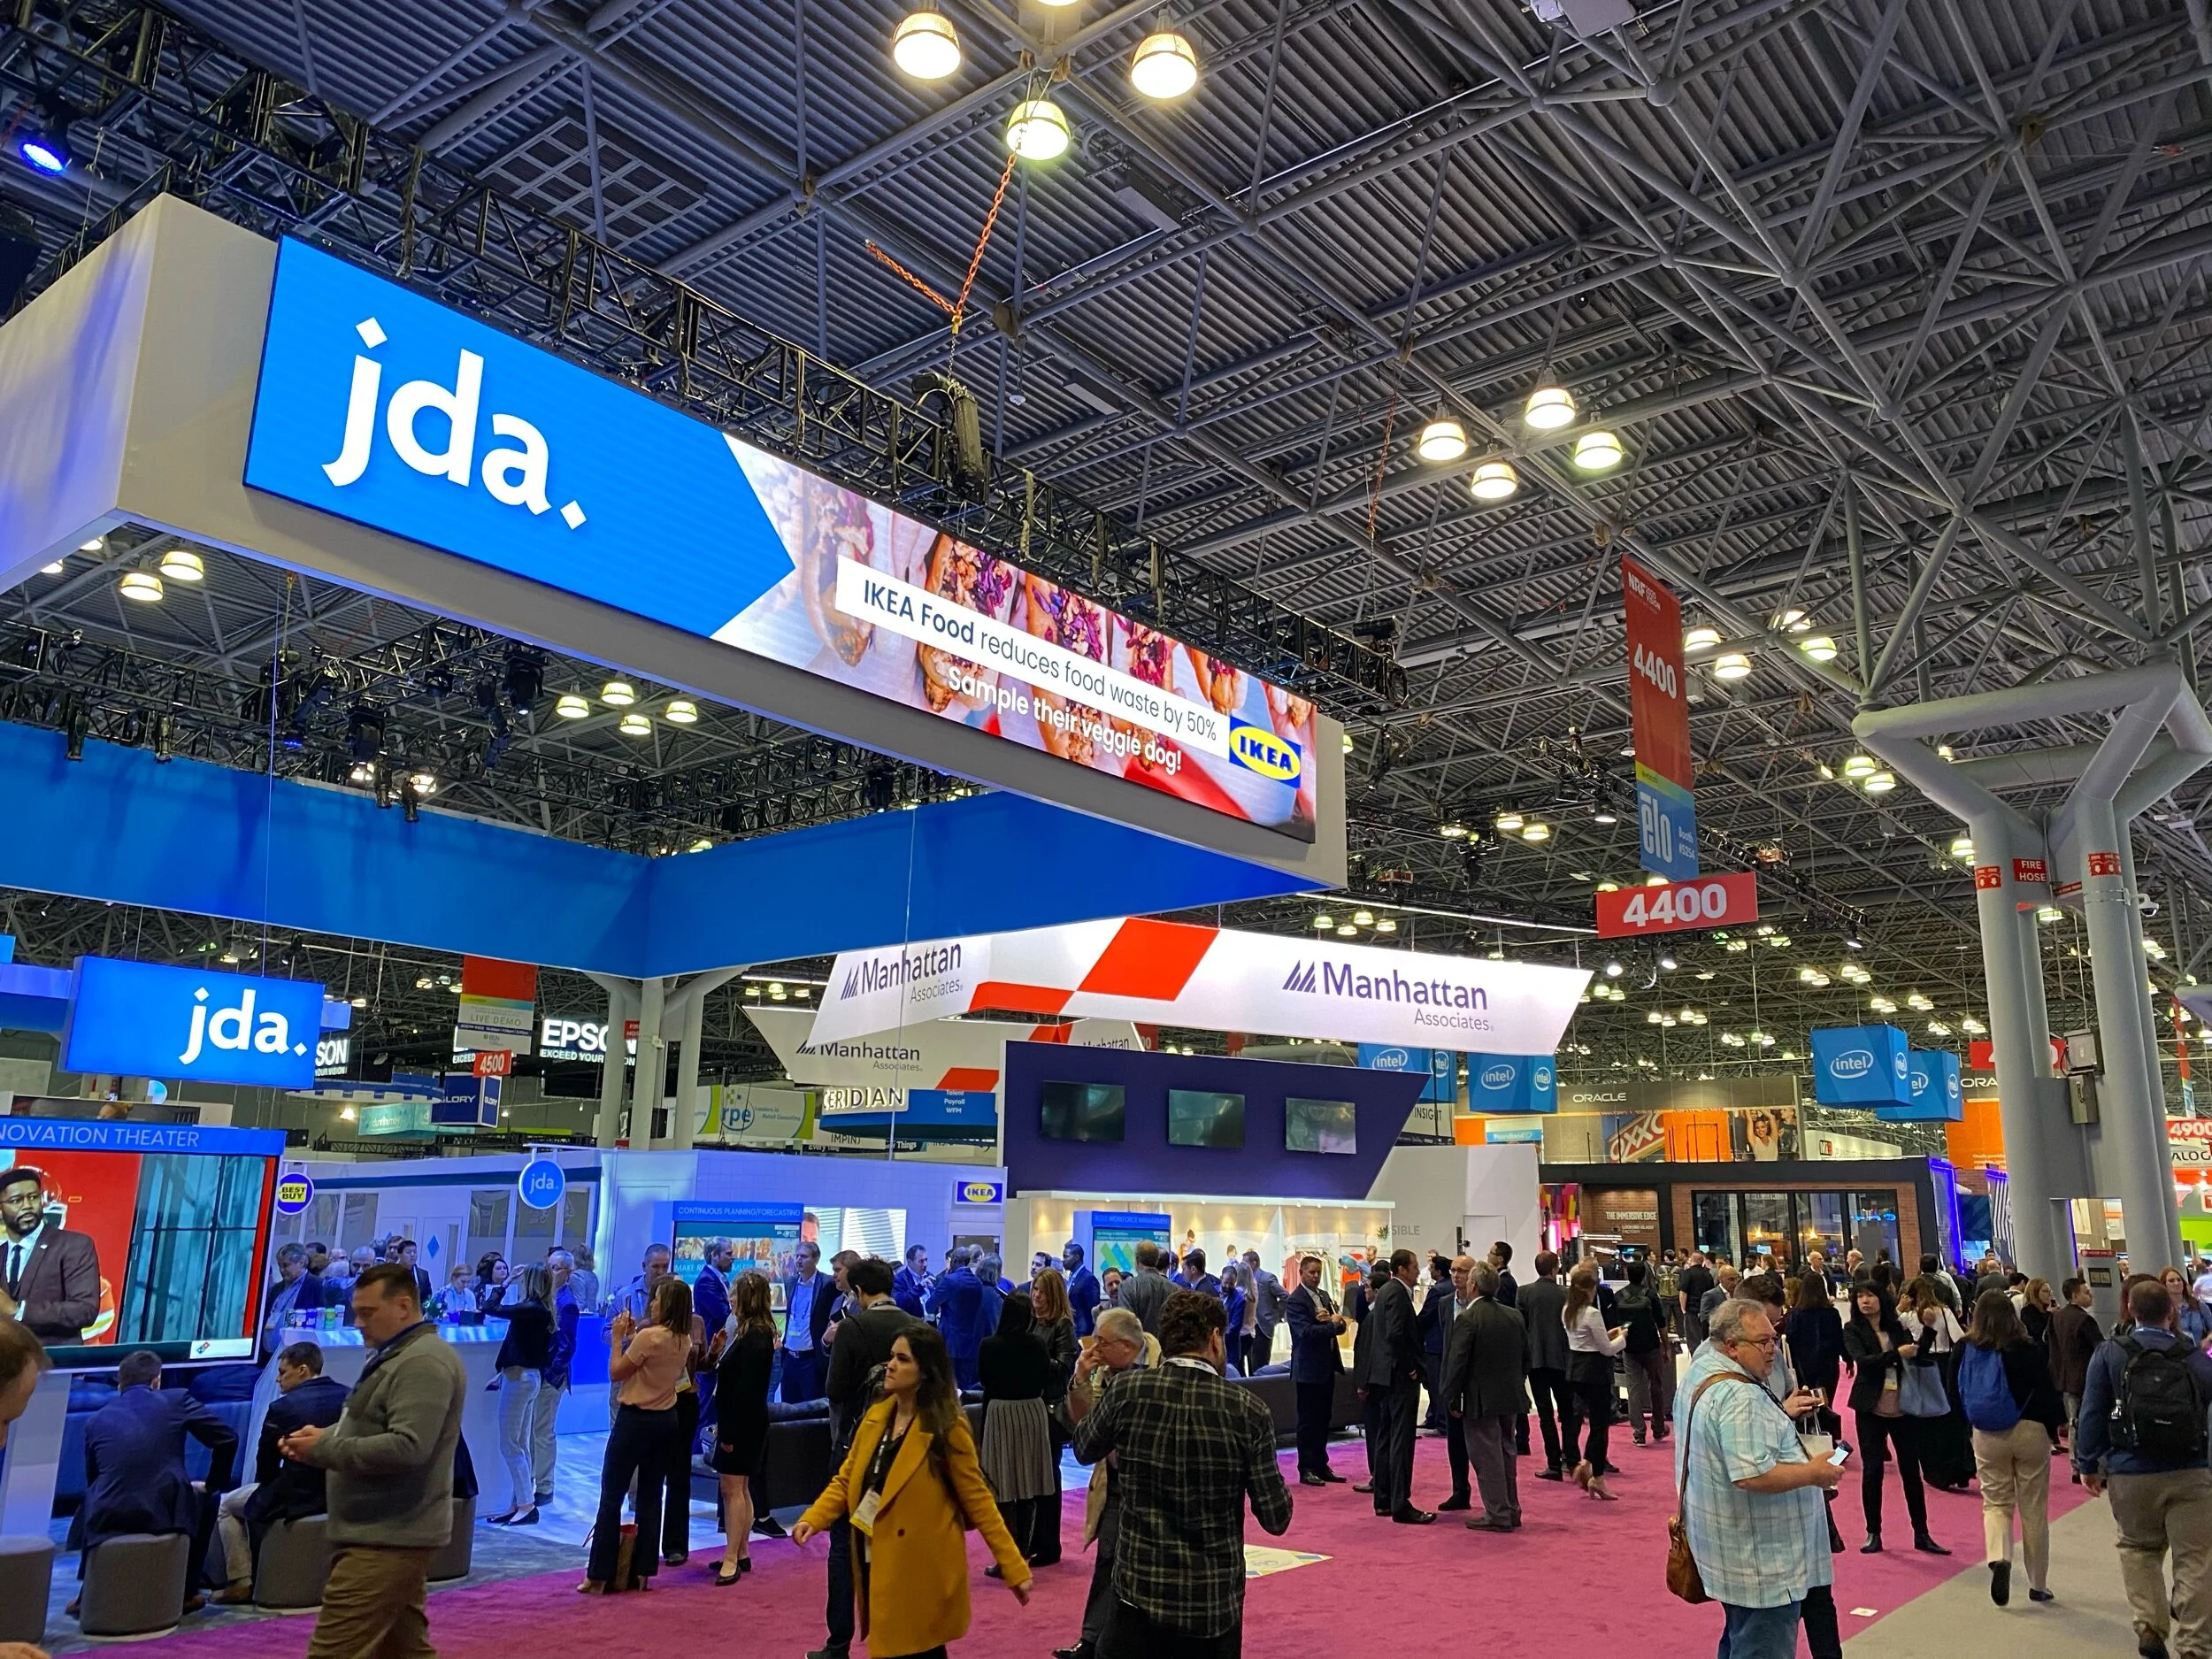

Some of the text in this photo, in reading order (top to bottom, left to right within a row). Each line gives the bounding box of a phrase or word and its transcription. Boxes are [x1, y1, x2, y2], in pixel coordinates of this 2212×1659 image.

[864, 580, 1217, 741] IKEA Food reduces food waste by 50%
[1633, 642, 1678, 700] 4400
[948, 665, 1182, 776] Sample their veggie dog!
[1240, 735, 1294, 773] IKEA
[2022, 860, 2042, 870] FIRE
[2019, 872, 2047, 882] HOSE
[1623, 884, 1727, 927] 4400
[862, 943, 962, 995] Manhattan
[910, 979, 960, 1004] Associates
[1323, 961, 1488, 1010] Manhattan
[471, 1014, 521, 1026] LIVE DEMO
[1414, 1009, 1490, 1031] Associates
[315, 1040, 348, 1066] SON
[452, 1053, 476, 1064] EXCEED
[540, 1048, 604, 1064] EXCEED YOUR
[820, 1042, 920, 1061] Manhattan
[480, 1054, 504, 1073] 4500
[873, 1061, 920, 1071] Associates
[1377, 1055, 1402, 1068] intel
[1836, 1056, 1867, 1071] intel
[1486, 1069, 1510, 1082] intel
[824, 1087, 905, 1110] CERIDIAN
[1572, 1093, 1626, 1102] ORACLE
[722, 1107, 751, 1126] rpe
[1414, 1108, 1442, 1121] INSIGT
[2170, 1122, 2212, 1137] 4900
[114, 1128, 200, 1148] THEATER
[896, 1141, 917, 1150] Things
[967, 1188, 994, 1197] IKEA
[678, 1206, 723, 1215] CONTINUOUS
[1606, 1211, 1616, 1220] THE
[1644, 1211, 1657, 1220] EDGE
